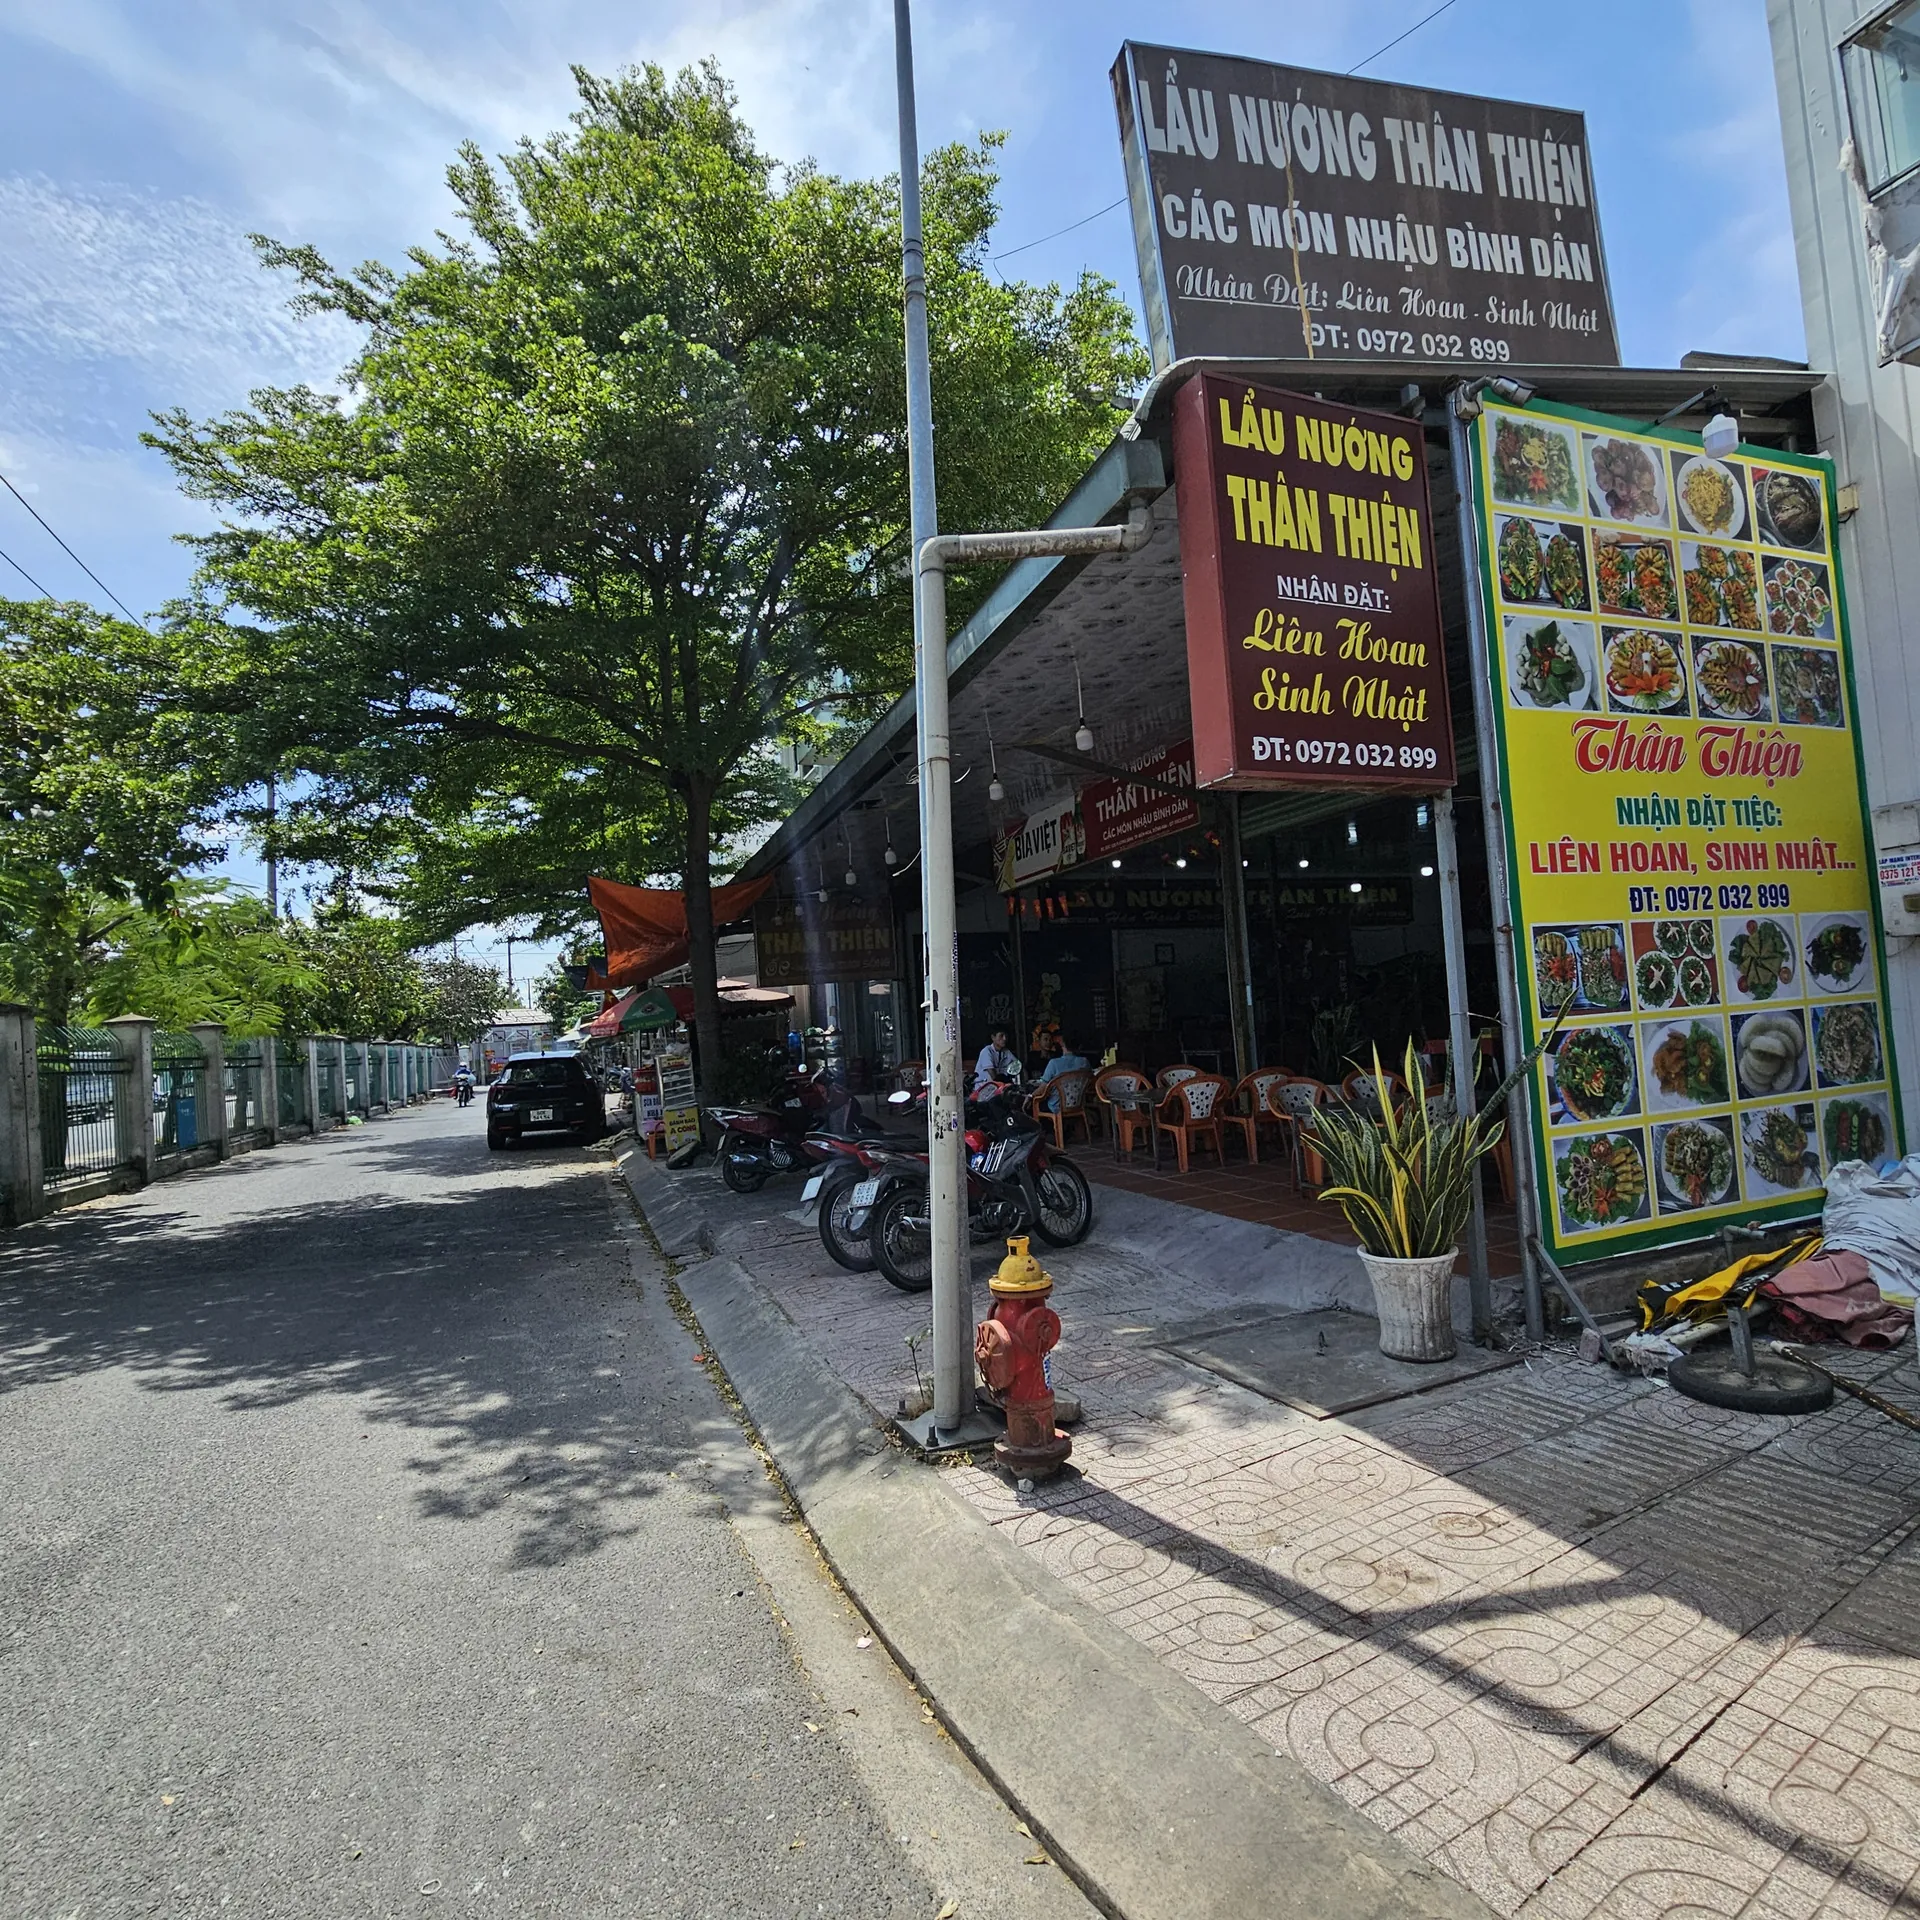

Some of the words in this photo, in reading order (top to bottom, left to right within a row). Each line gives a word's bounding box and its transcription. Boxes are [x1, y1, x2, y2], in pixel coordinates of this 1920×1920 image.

[1138, 58, 1220, 160] LẨU
[1229, 87, 1377, 182] NƯỚNG
[1383, 111, 1482, 195] THÂN
[1487, 128, 1586, 222] THIỆN
[1162, 188, 1238, 245] CÁC
[1247, 200, 1338, 256] MÓN
[1344, 214, 1439, 272] NHẬU
[1446, 222, 1525, 275] BÌNH
[1531, 232, 1594, 283] DÂN
[1176, 264, 1256, 304] Nhận
[1335, 280, 1392, 315] Liên
[1398, 286, 1468, 321] Hoan
[1486, 294, 1537, 328] Sinh
[1542, 301, 1600, 336] Nhật
[1303, 322, 1350, 350] ĐT:
[1357, 328, 1415, 356] 0972
[1421, 333, 1463, 361] 032
[1469, 338, 1511, 364] 899
[1218, 387, 1285, 457] LẨU
[1296, 415, 1414, 482] NƯỚNG
[1226, 470, 1322, 554] THÂN
[1328, 490, 1423, 581] THIỆN
[1242, 608, 1327, 658] Liên
[1335, 618, 1429, 668] Hoan
[1252, 667, 1335, 716] Sinh
[1342, 675, 1429, 733] Nhật
[1251, 735, 1291, 763] ĐT:
[1296, 740, 1351, 766] 0972
[1355, 743, 1395, 768] 032
[1399, 745, 1437, 770] 899
[1572, 717, 1687, 775] Thân
[1696, 724, 1804, 788] Thiện
[1095, 780, 1137, 822] THÂN
[1103, 826, 1117, 841] CÁC
[1116, 820, 1132, 836] MÓN
[1133, 813, 1152, 829] NHẬU
[1153, 805, 1171, 822] BÌNH
[1171, 798, 1189, 815] DÂN
[1616, 792, 1681, 832] NHẬN
[1687, 793, 1726, 832] ĐẶT
[1731, 797, 1782, 832] TIỆC:
[1014, 832, 1033, 862] BIA
[1032, 819, 1057, 854] VIỆT
[1530, 836, 1601, 874] LIÊN
[1609, 842, 1699, 876] HOAN,
[1705, 842, 1767, 872] SINH
[1776, 836, 1857, 876] NHẬT...
[1880, 868, 1899, 880] 0375
[1901, 867, 1914, 878] 121
[1629, 885, 1660, 913] ĐT:
[1665, 885, 1714, 912] 0972
[1719, 884, 1752, 910] 032
[1757, 883, 1790, 909] 899
